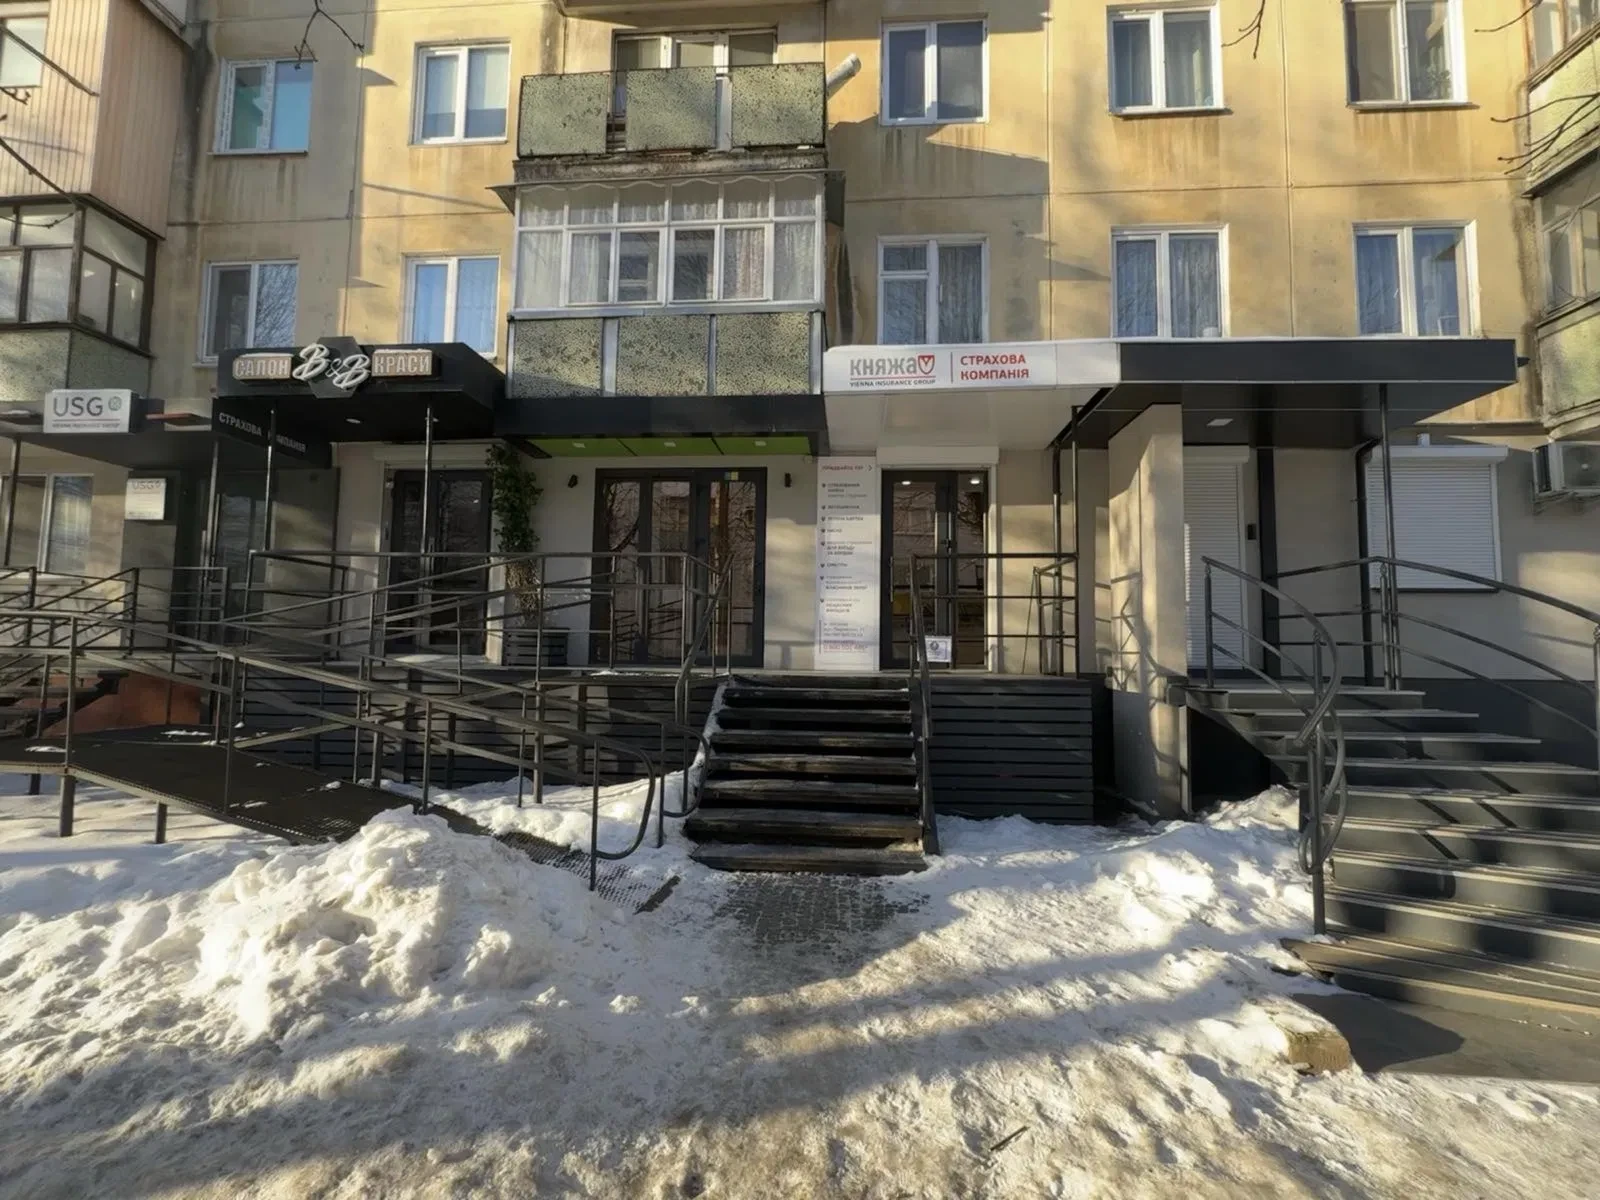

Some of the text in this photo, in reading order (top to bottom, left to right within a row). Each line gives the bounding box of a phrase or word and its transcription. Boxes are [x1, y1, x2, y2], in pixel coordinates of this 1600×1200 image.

[234, 358, 290, 376] САЛОН
[373, 354, 431, 374] КРАСИ
[960, 354, 1026, 366] СТРАХОВА
[960, 368, 1029, 381] КОМПАНІЯ
[850, 380, 874, 388] VIENNA
[53, 396, 103, 418] USG
[219, 412, 262, 436] СТРАХОВА
